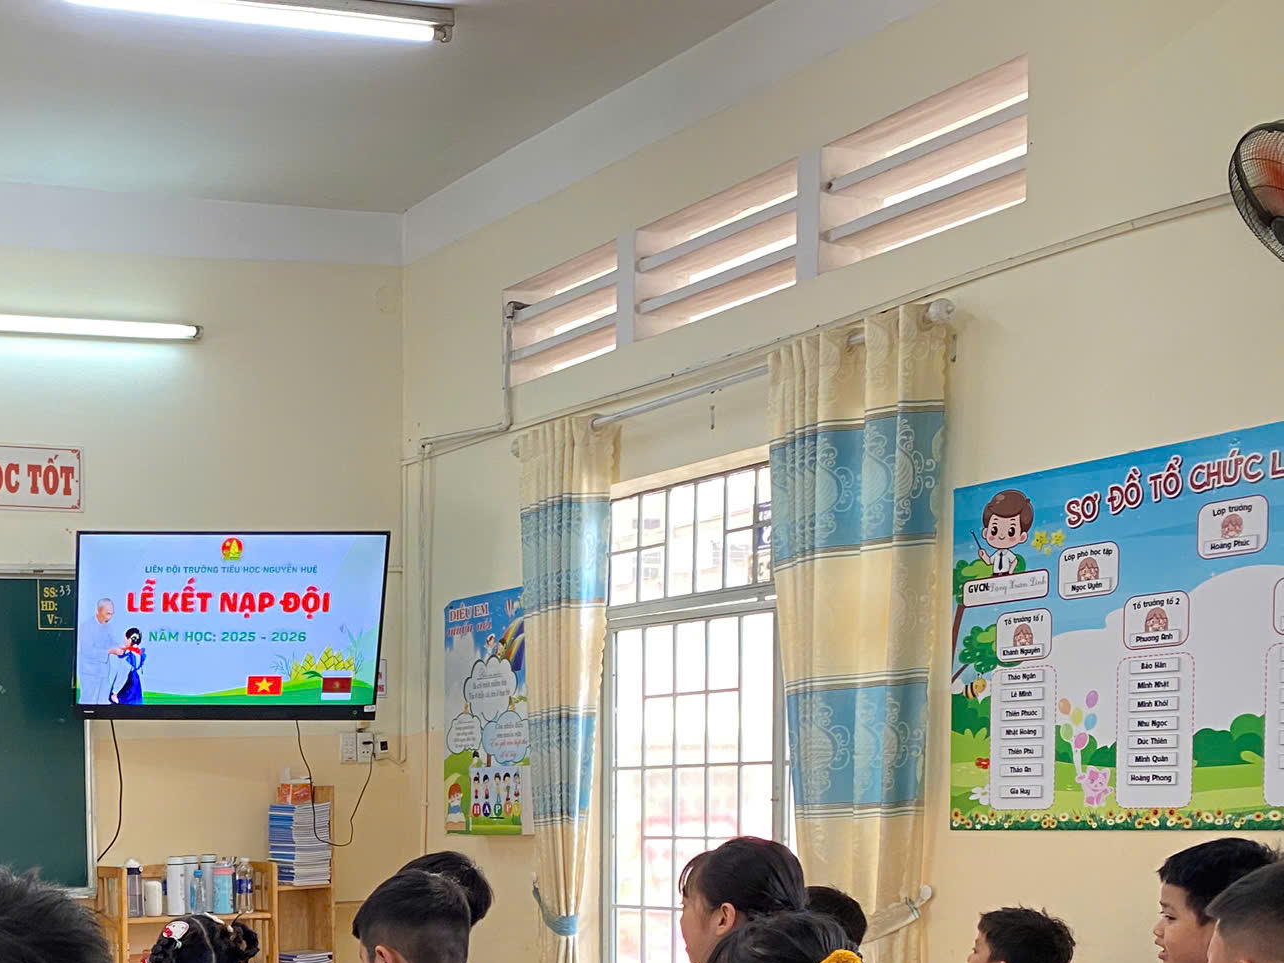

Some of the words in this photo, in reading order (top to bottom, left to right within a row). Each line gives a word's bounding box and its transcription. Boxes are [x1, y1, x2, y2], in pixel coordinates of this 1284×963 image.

[28, 455, 74, 495] TỐT
[1066, 494, 1100, 526] SƠ
[1107, 468, 1142, 513] ĐỒ
[1149, 456, 1182, 500] TỔ
[1190, 449, 1263, 492] CHỨC
[145, 563, 163, 573] LIÊN
[166, 564, 181, 575] ĐỘI
[183, 564, 218, 574] TRƯỜNG
[222, 563, 240, 574] TIỂU
[243, 566, 260, 575] HỌC
[263, 563, 298, 574] NGUYỄN
[301, 564, 317, 574] HUỆ
[127, 579, 156, 613] LỄ
[162, 578, 212, 613] KẾT
[220, 592, 275, 618] NẠP
[280, 586, 330, 619] ĐỘI
[149, 628, 178, 642] NĂM
[185, 632, 217, 645] HỌC:
[221, 632, 256, 642] 2025
[272, 632, 306, 642] 2026
